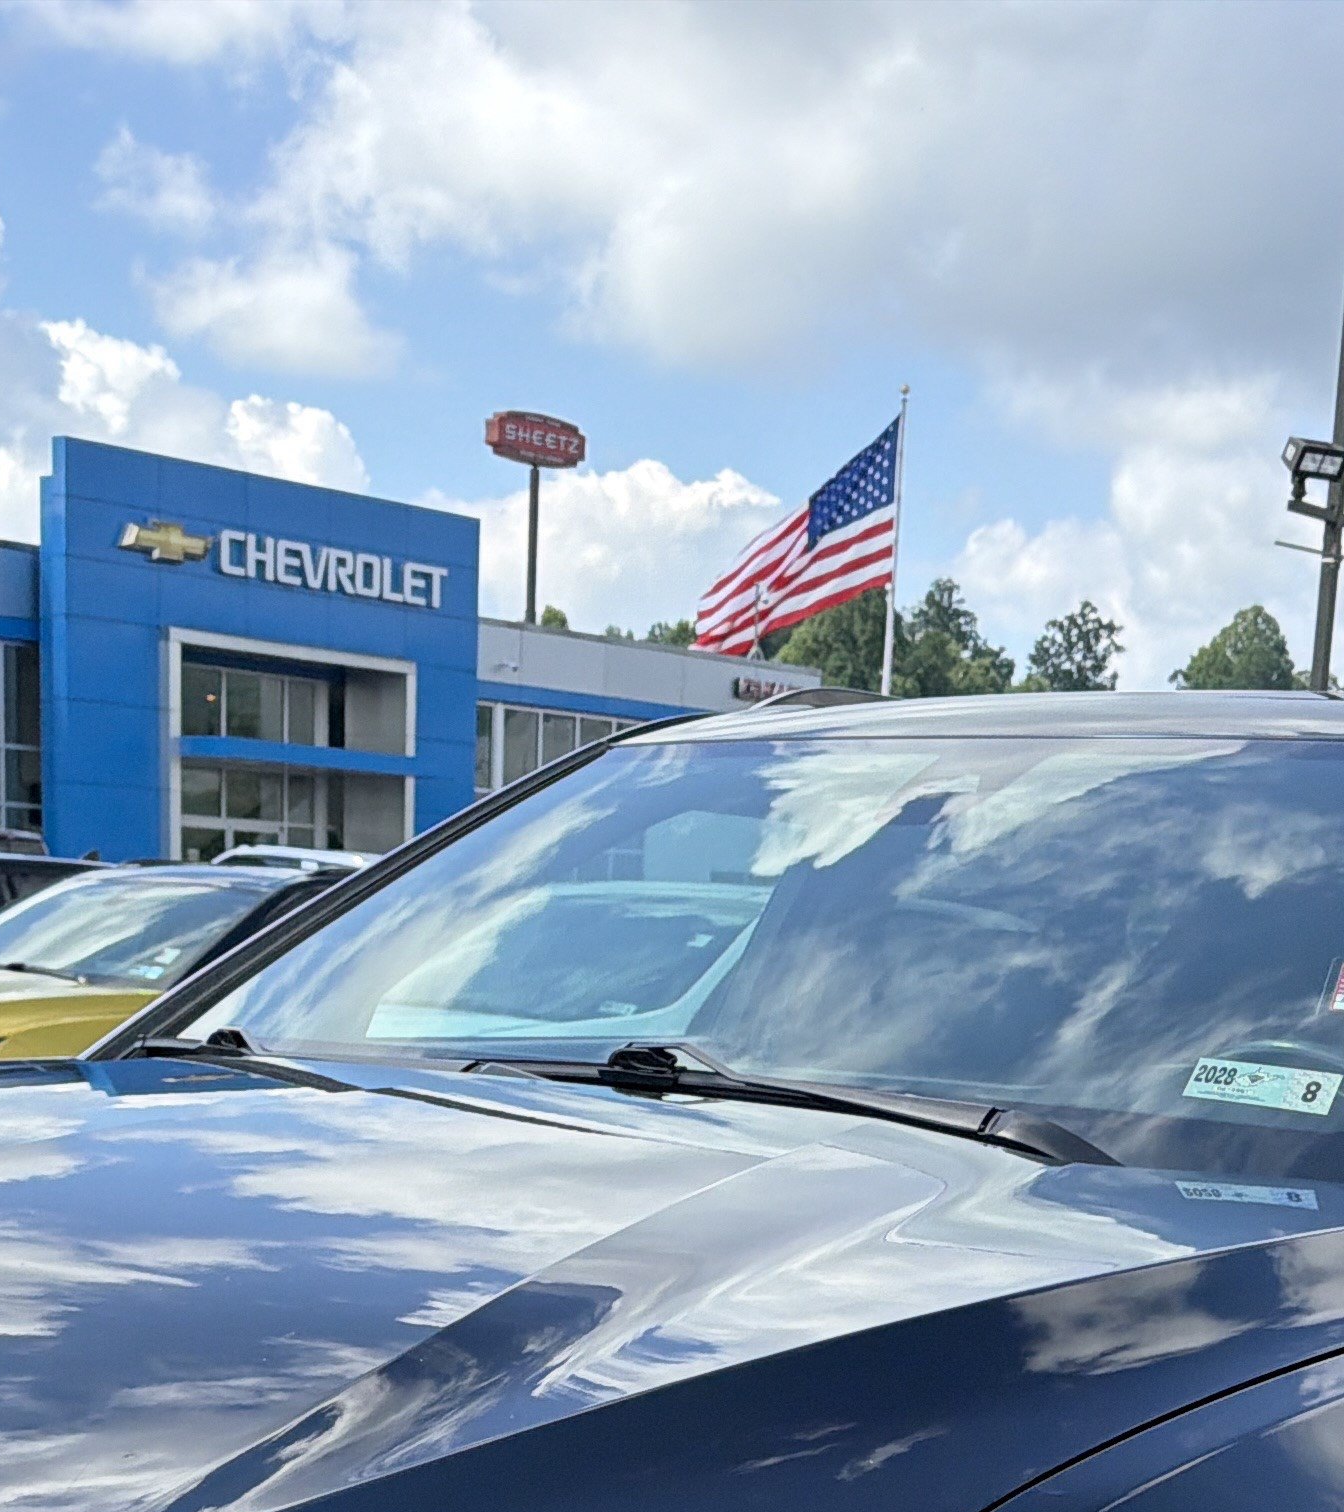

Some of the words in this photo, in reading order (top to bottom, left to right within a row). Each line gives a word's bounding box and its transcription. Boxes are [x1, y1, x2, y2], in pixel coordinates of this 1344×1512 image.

[504, 422, 580, 454] SHEETZ
[220, 529, 448, 609] CHEVROLET
[1193, 1064, 1238, 1086] 2028
[1301, 1080, 1322, 1103] 8
